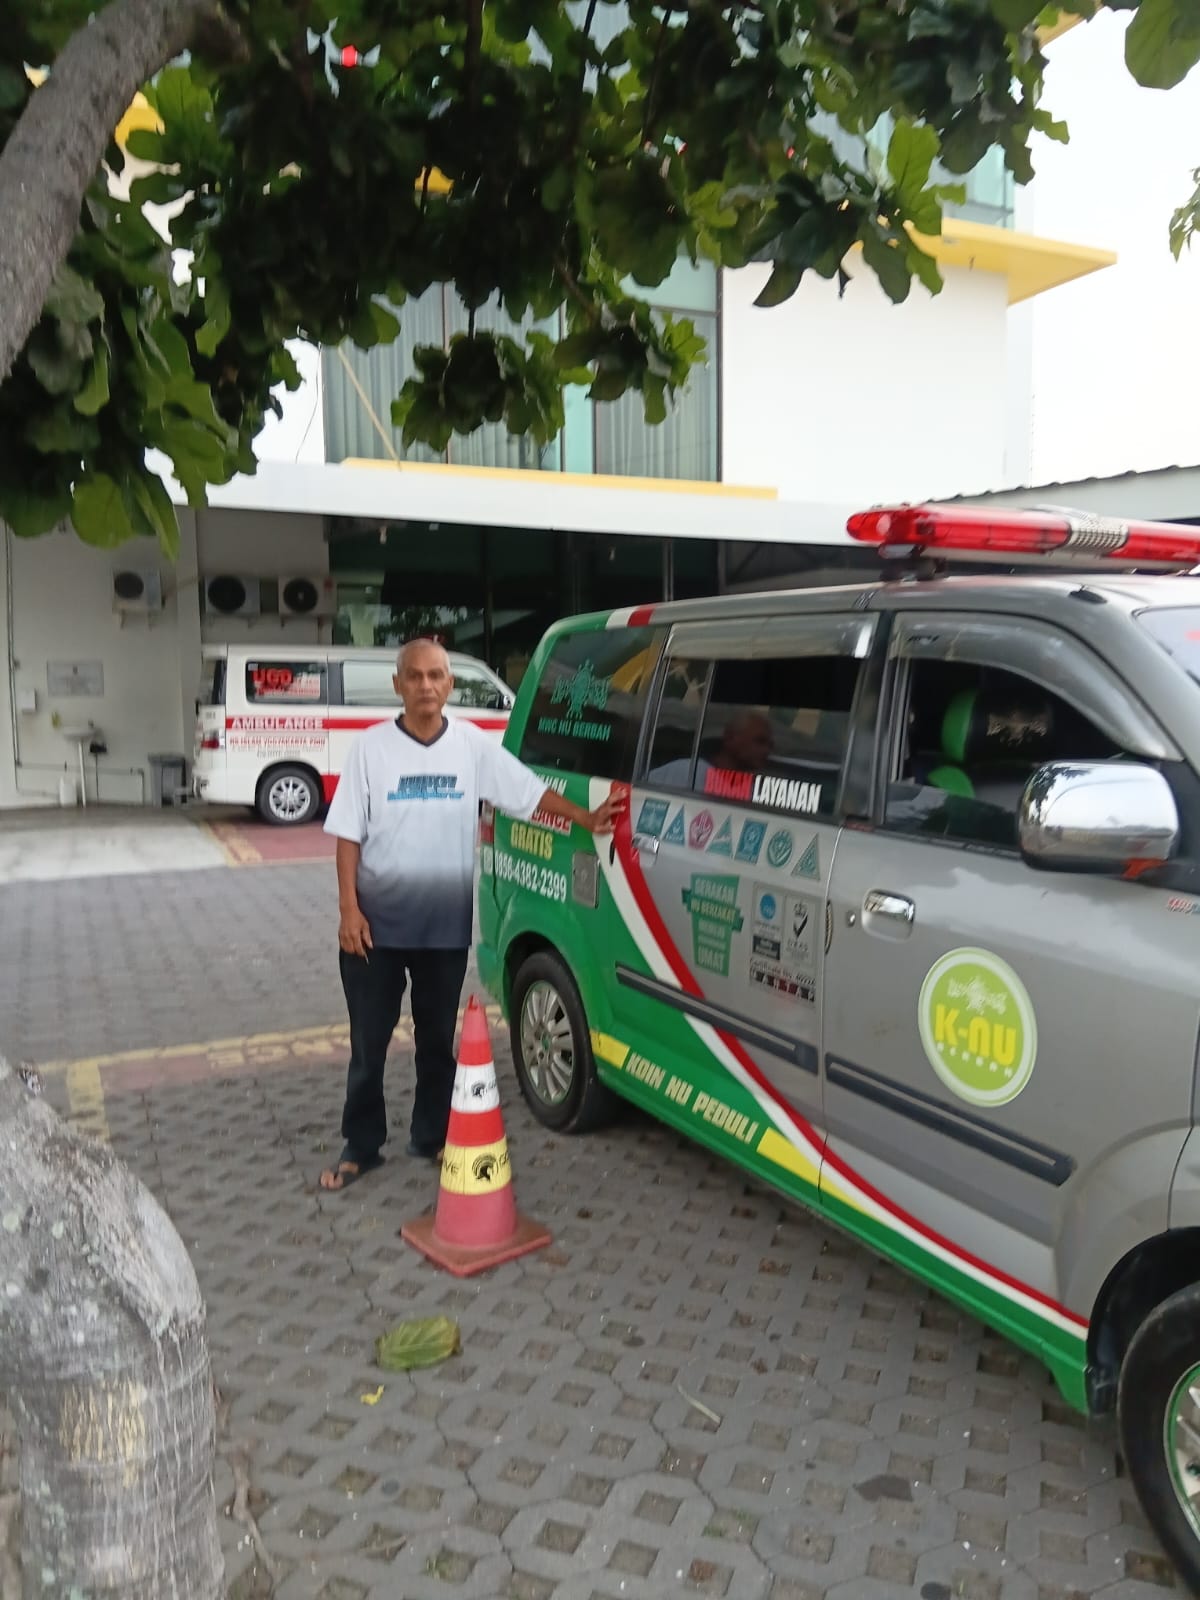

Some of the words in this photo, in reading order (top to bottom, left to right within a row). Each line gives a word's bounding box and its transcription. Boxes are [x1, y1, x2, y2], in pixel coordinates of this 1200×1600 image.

[752, 774, 822, 814] LAYANAN
[511, 821, 553, 860] GRATIS
[495, 849, 567, 904] 0856-4382-2399
[625, 1053, 666, 1090] KOIN
[664, 1075, 693, 1106] NU
[692, 1091, 759, 1144] PEDULI
